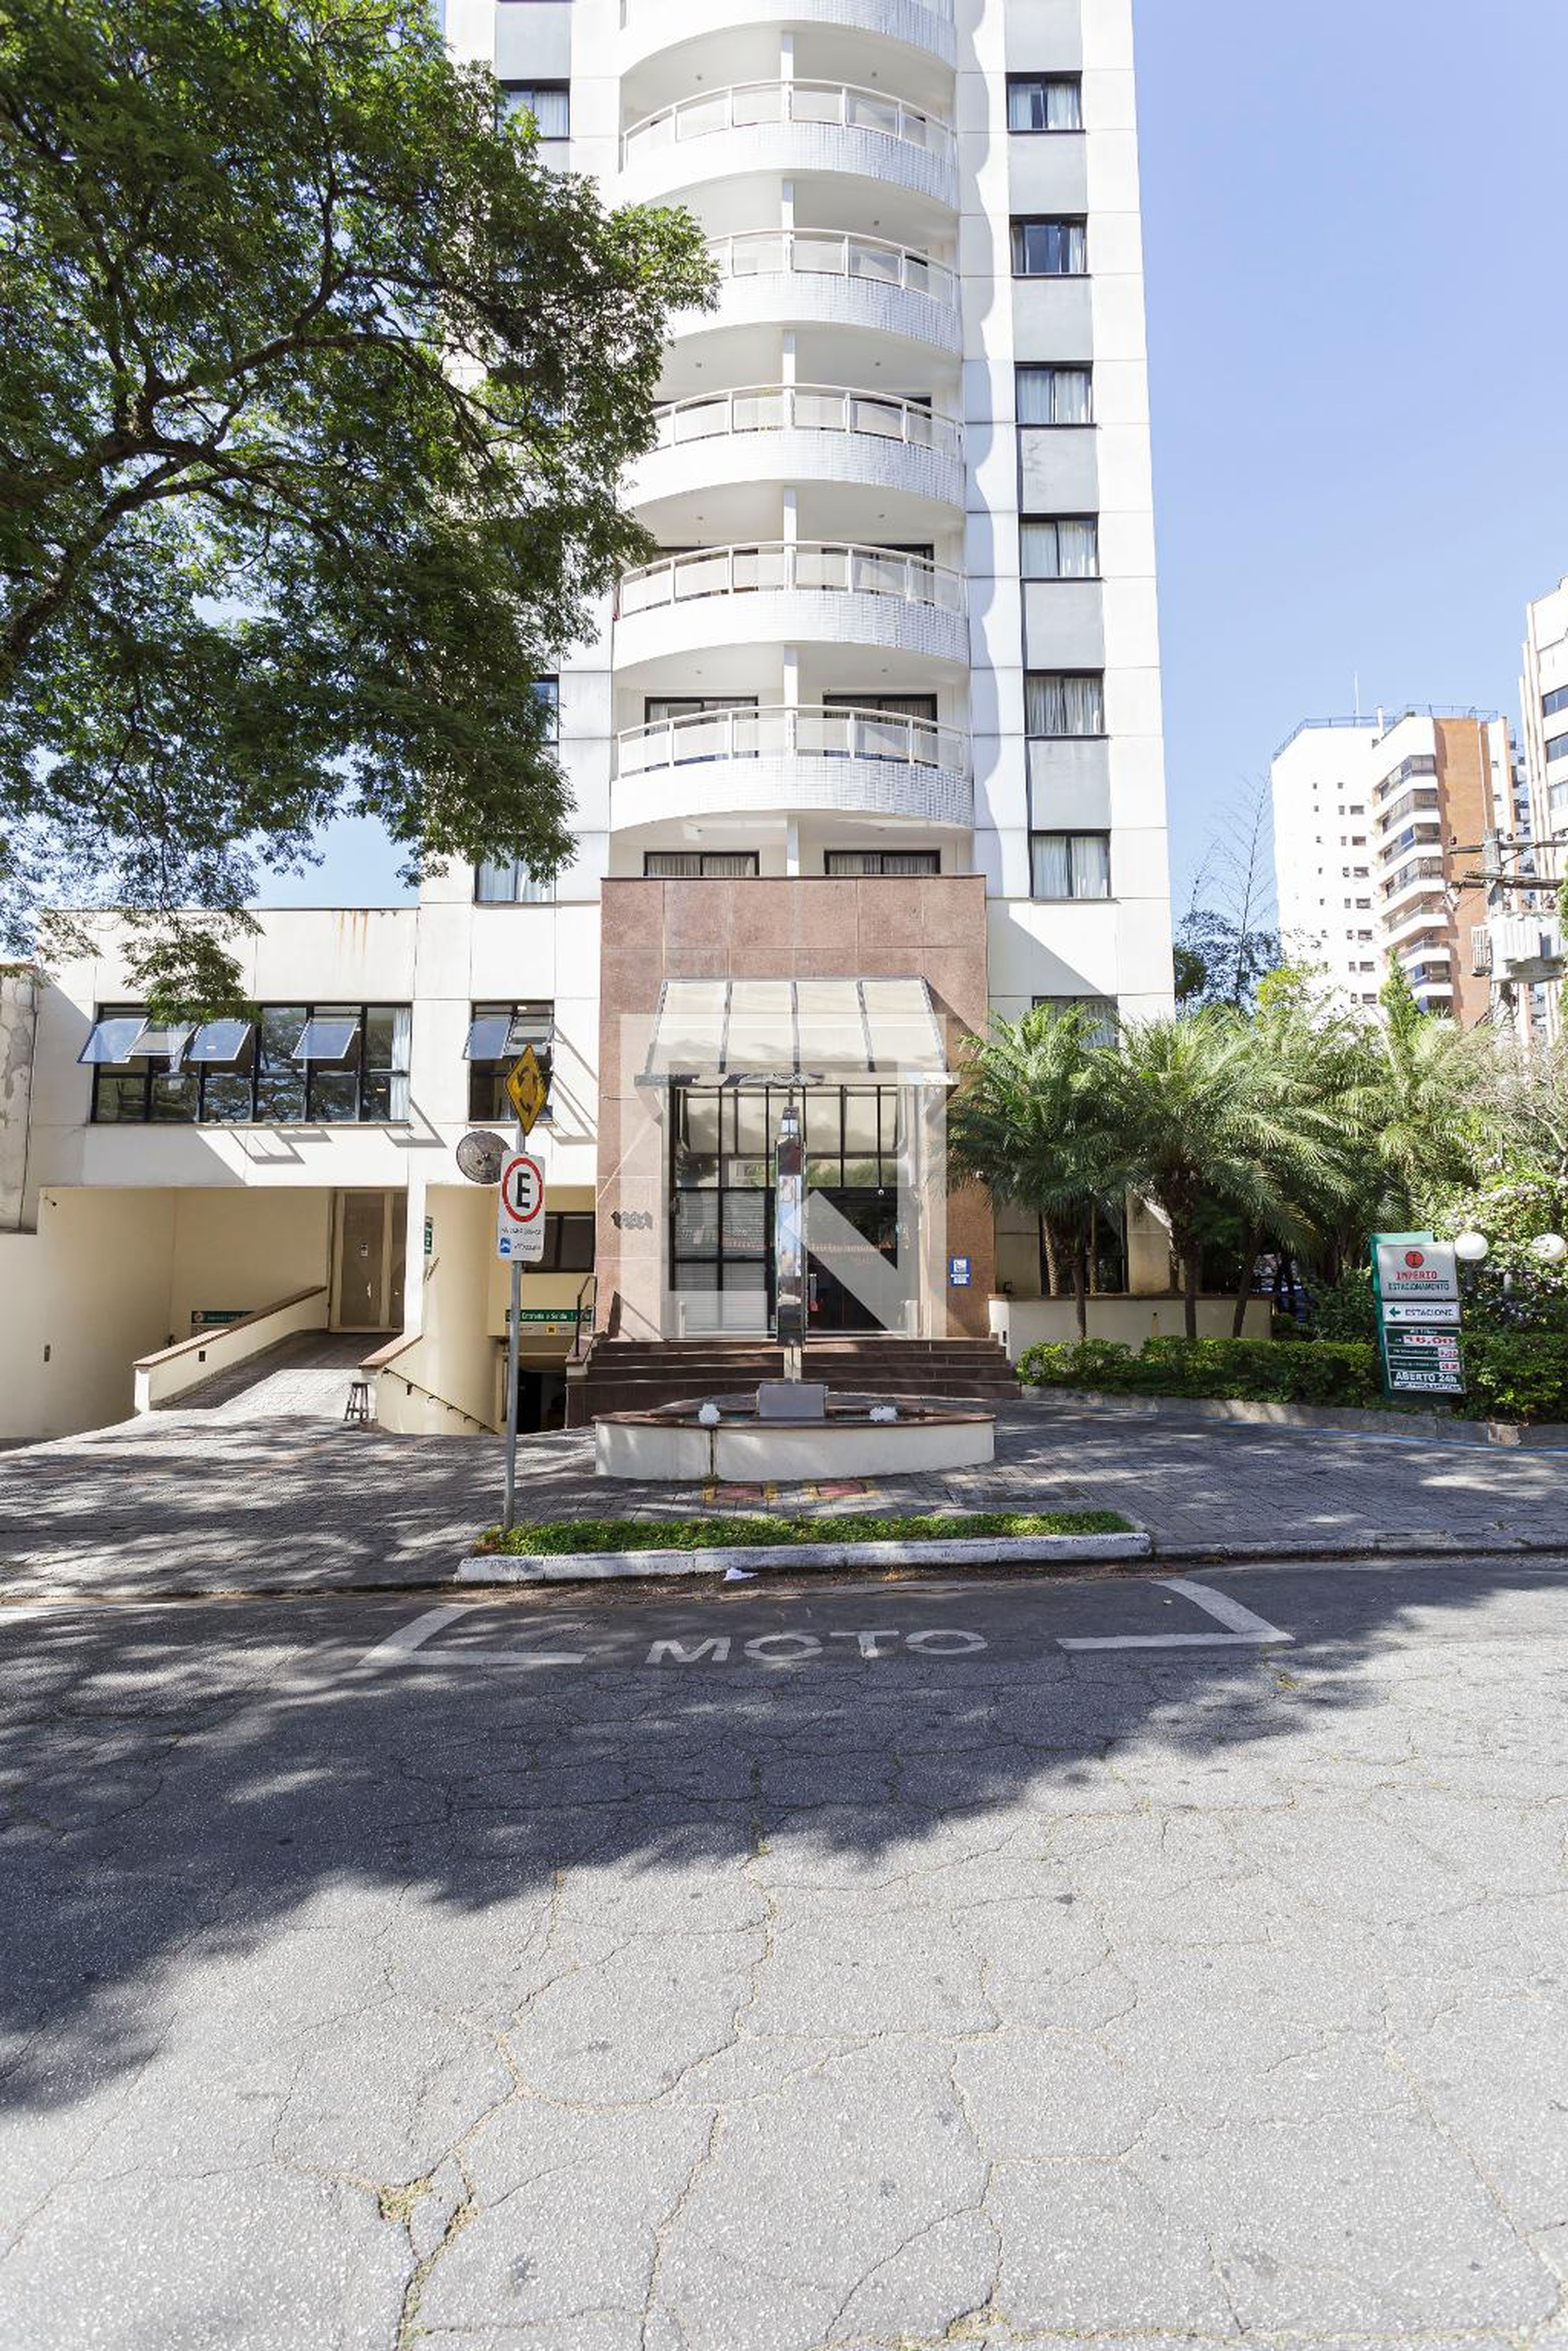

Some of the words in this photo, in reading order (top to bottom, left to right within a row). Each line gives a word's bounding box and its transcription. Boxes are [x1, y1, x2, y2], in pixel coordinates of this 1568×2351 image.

[516, 1172, 530, 1209] E
[1396, 1372, 1436, 1382] ABERTO
[644, 1629, 989, 1664] MOTO
